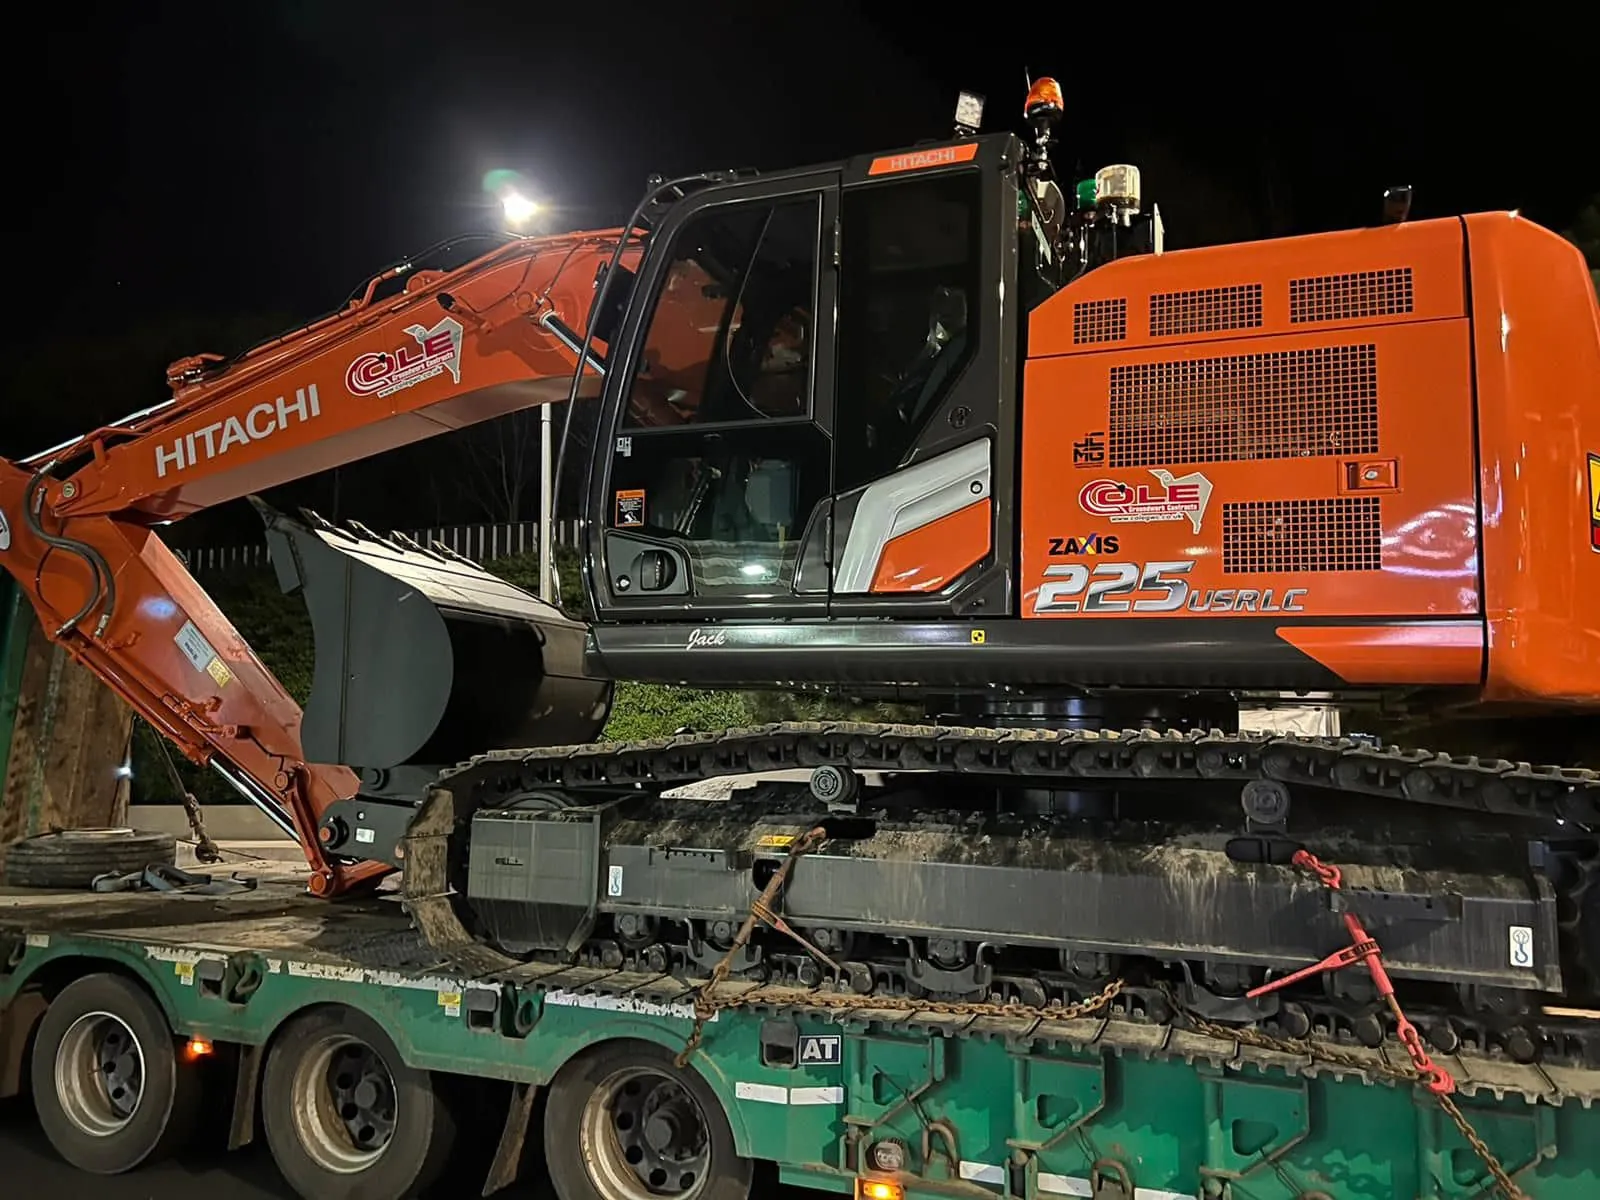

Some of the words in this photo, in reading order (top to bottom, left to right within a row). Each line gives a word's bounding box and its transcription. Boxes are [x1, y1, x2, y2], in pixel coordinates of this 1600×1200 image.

[891, 149, 955, 169] HITACHI
[155, 383, 321, 478] HITACHI
[1048, 533, 1120, 556] ZAXIS
[1034, 560, 1196, 613] 225
[686, 628, 727, 651] Jack
[802, 1038, 838, 1059] AT
